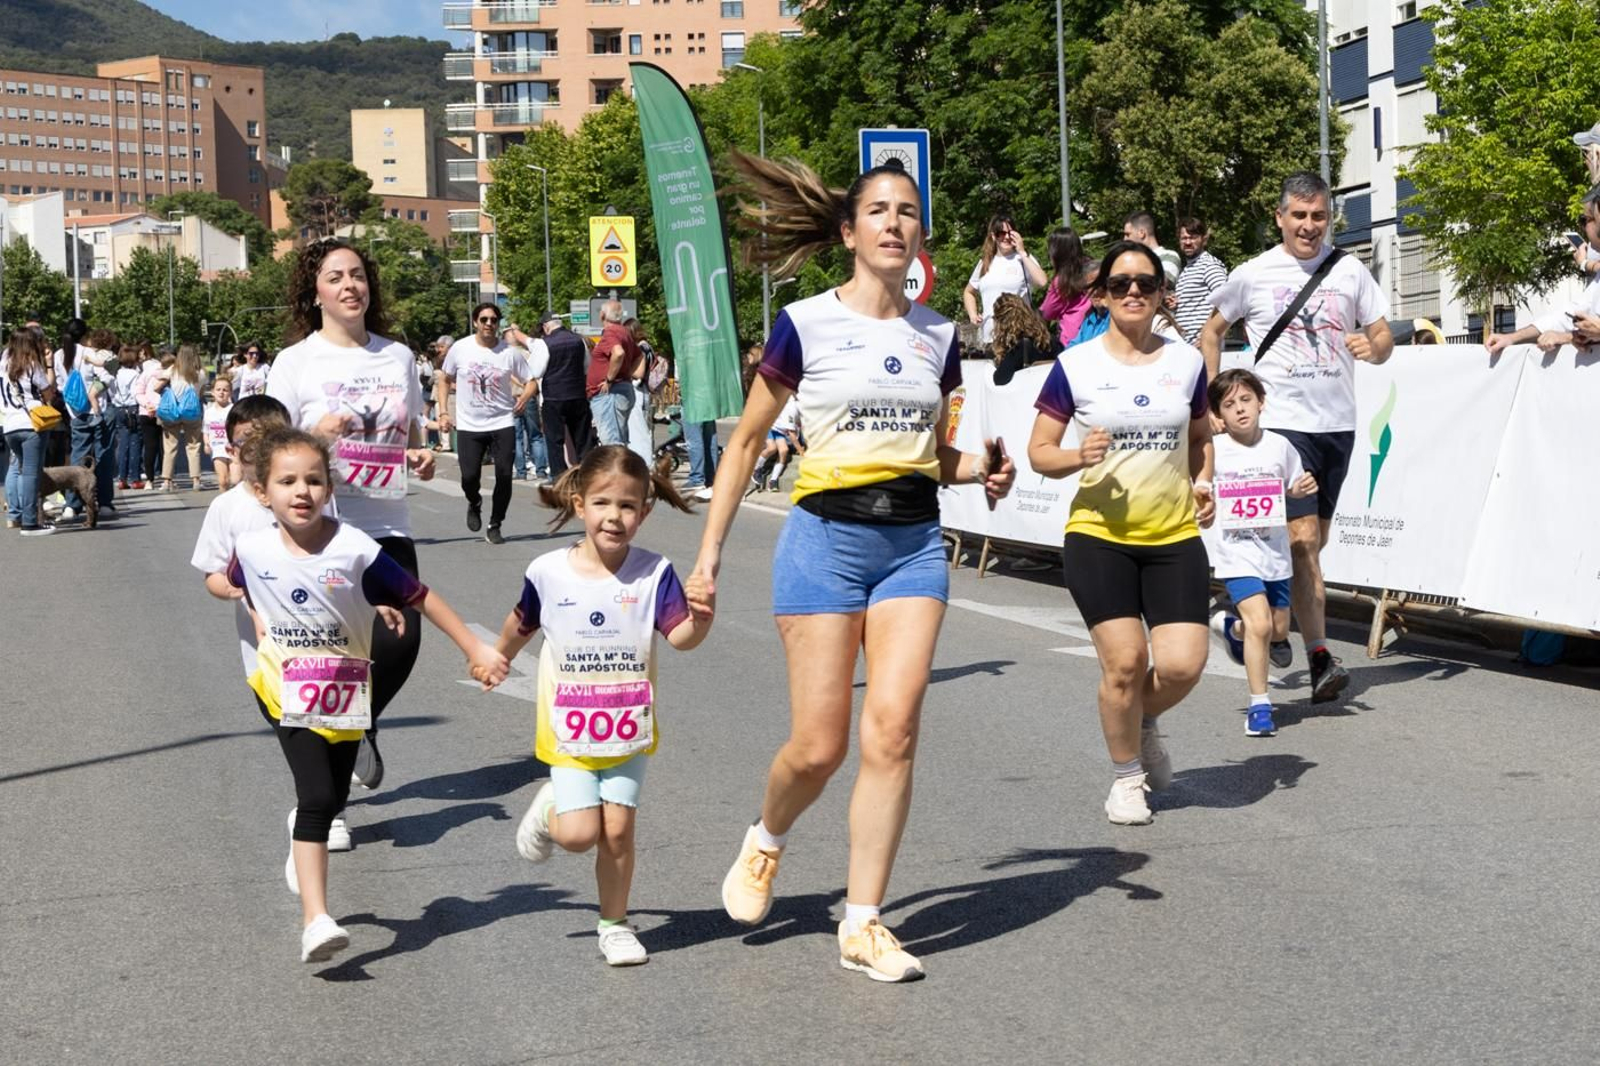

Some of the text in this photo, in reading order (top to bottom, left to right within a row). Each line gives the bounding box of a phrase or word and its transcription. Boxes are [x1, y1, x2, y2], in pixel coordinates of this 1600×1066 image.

[605, 264, 622, 273] 20
[848, 399, 878, 409] CLUB
[881, 399, 894, 408] DE
[850, 408, 897, 419] SANTA
[836, 419, 935, 432] LOS APÓSTOLE
[1112, 431, 1143, 440] ANTA
[1166, 431, 1180, 440] DE
[340, 441, 371, 454] XXVII
[346, 462, 395, 487] 777
[1231, 496, 1274, 519] 459
[1335, 512, 1405, 531] Patronato Municipal de
[1339, 530, 1366, 547] Deportes
[1367, 534, 1376, 547] de
[271, 626, 308, 638] SANTA
[564, 645, 583, 653] CLUB
[287, 657, 326, 670] XXVII
[566, 653, 600, 662] SANTA
[621, 652, 636, 662] DE
[559, 662, 646, 673] LOS APÓSTOLES
[558, 683, 592, 696] XXVII
[298, 683, 357, 714] 907
[566, 710, 638, 742] 906
